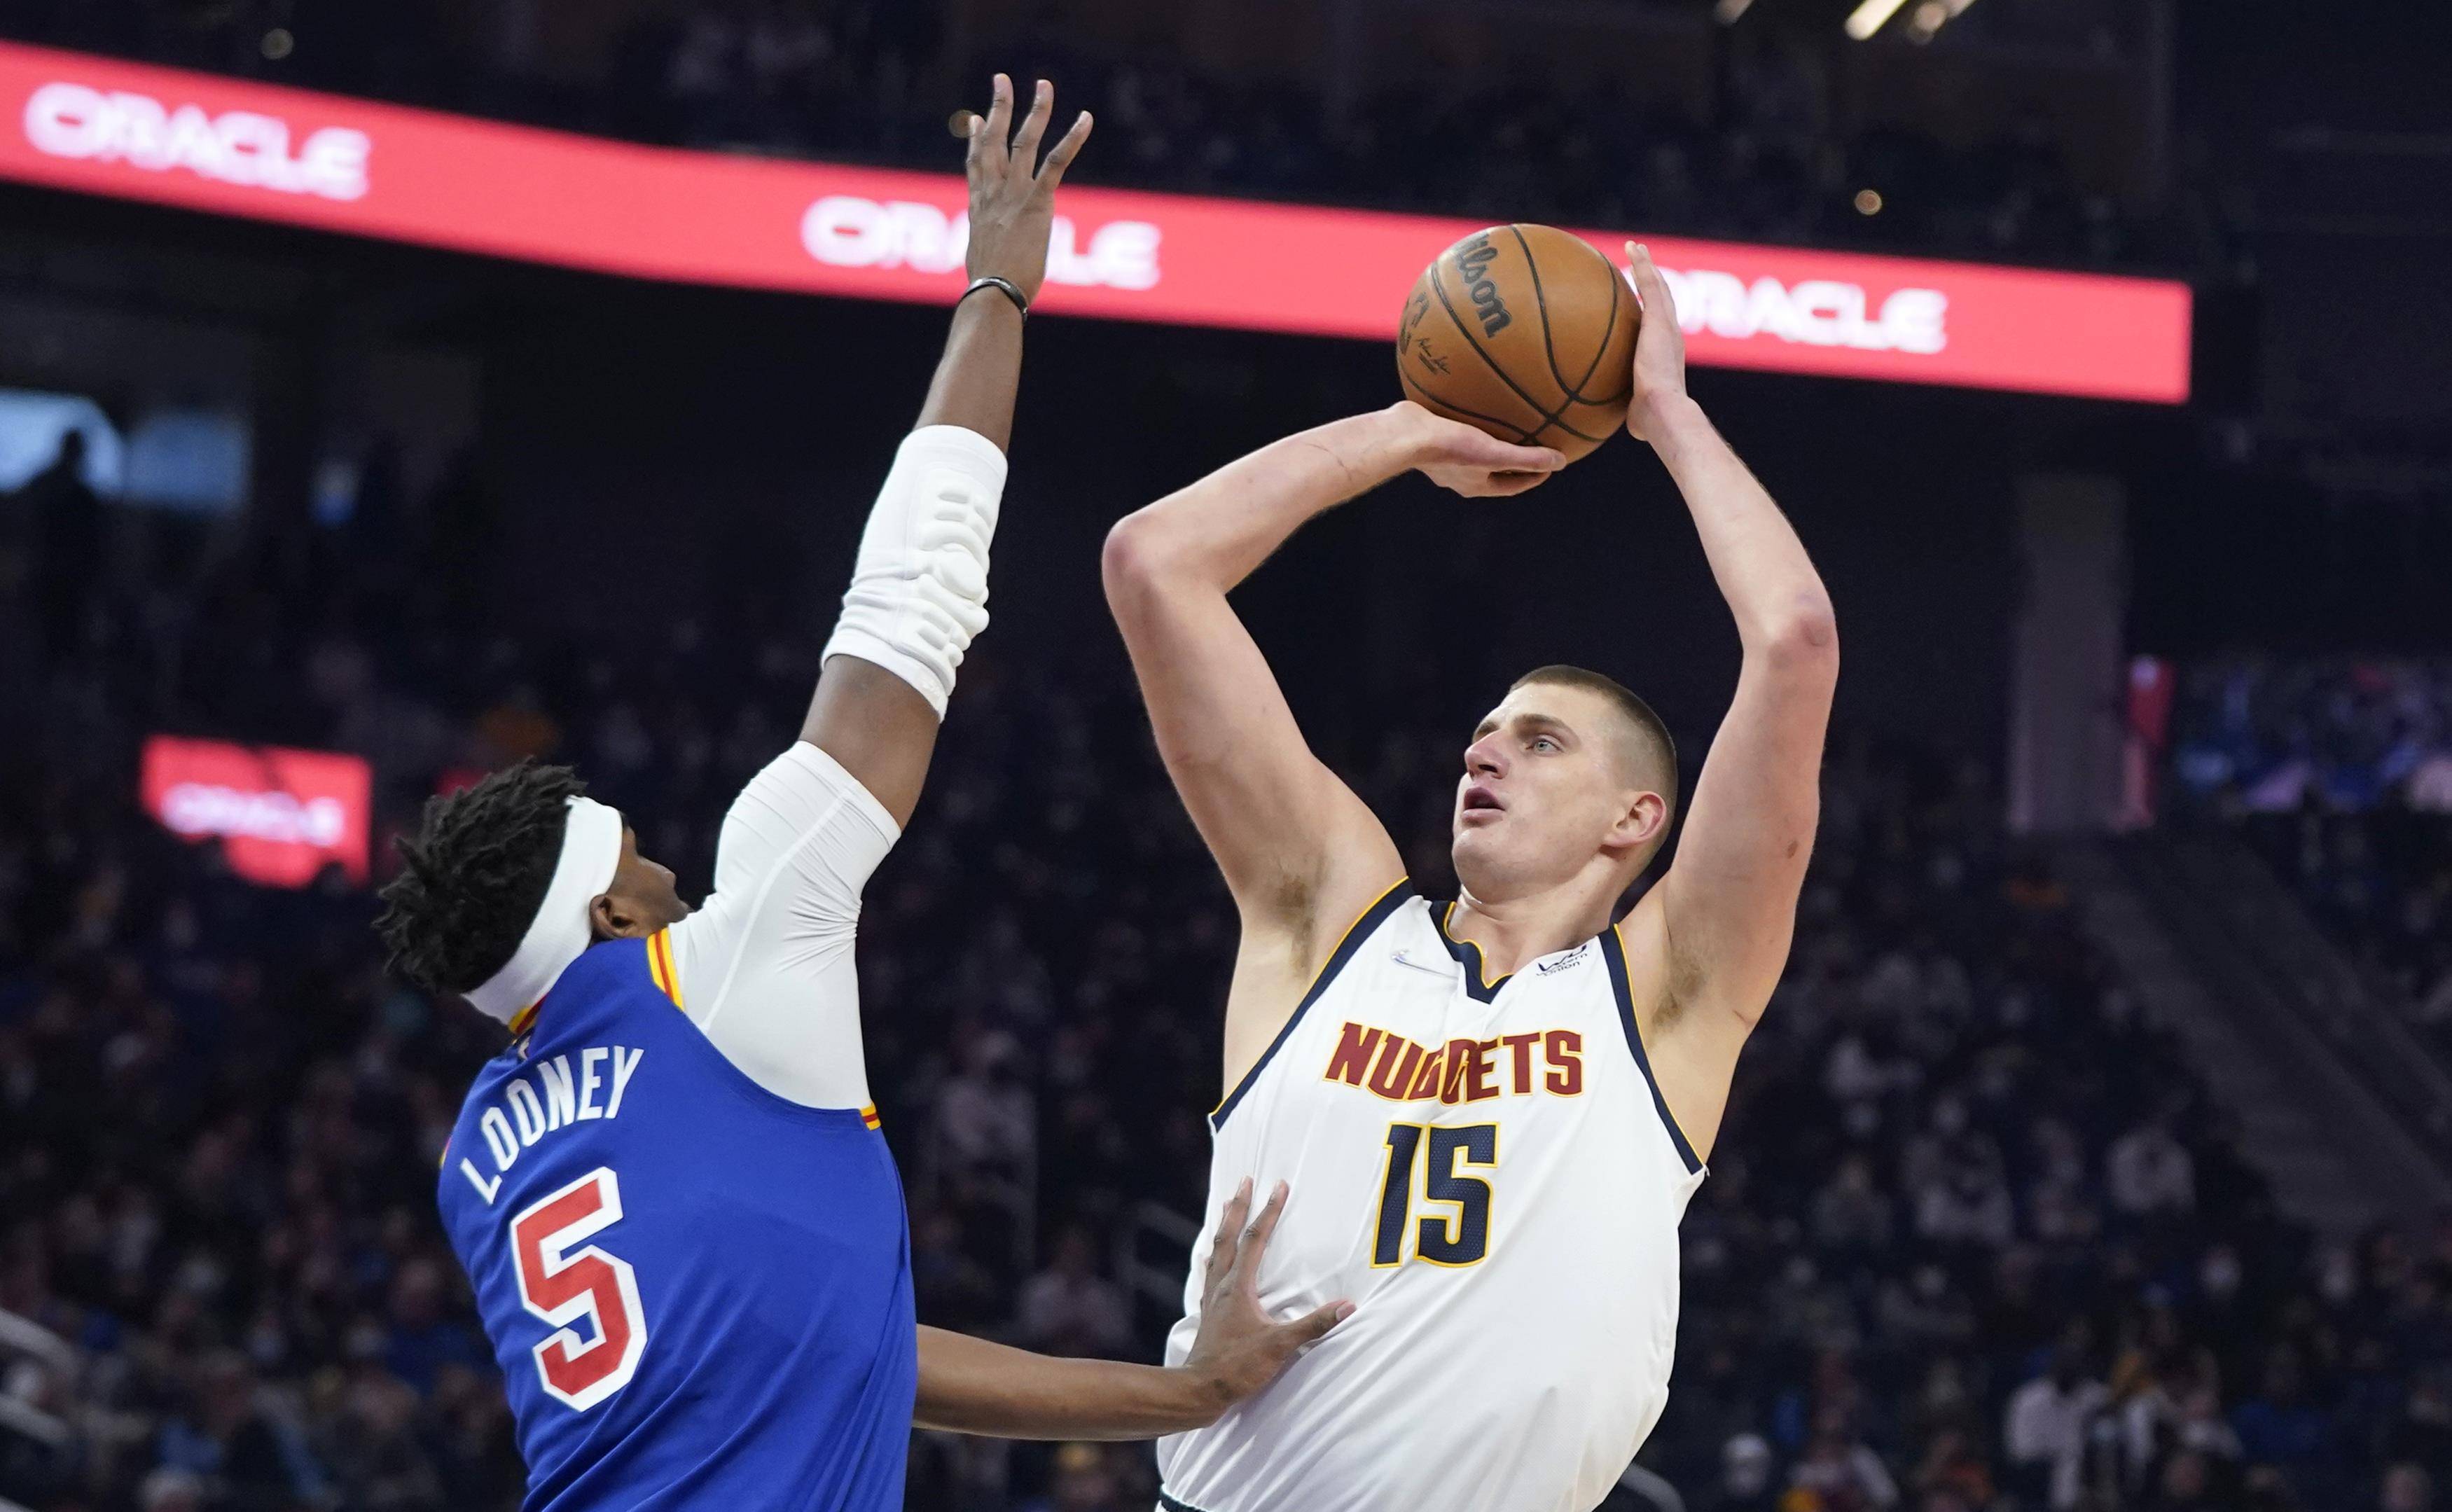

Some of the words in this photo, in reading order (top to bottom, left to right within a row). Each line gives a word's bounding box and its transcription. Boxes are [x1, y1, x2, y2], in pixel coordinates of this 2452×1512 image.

[23, 82, 371, 201] ORACLE
[801, 196, 1162, 291] ORLE
[459, 1046, 644, 1205] LOONEY
[1370, 1121, 1501, 1269] 15
[509, 1165, 648, 1413] 5
